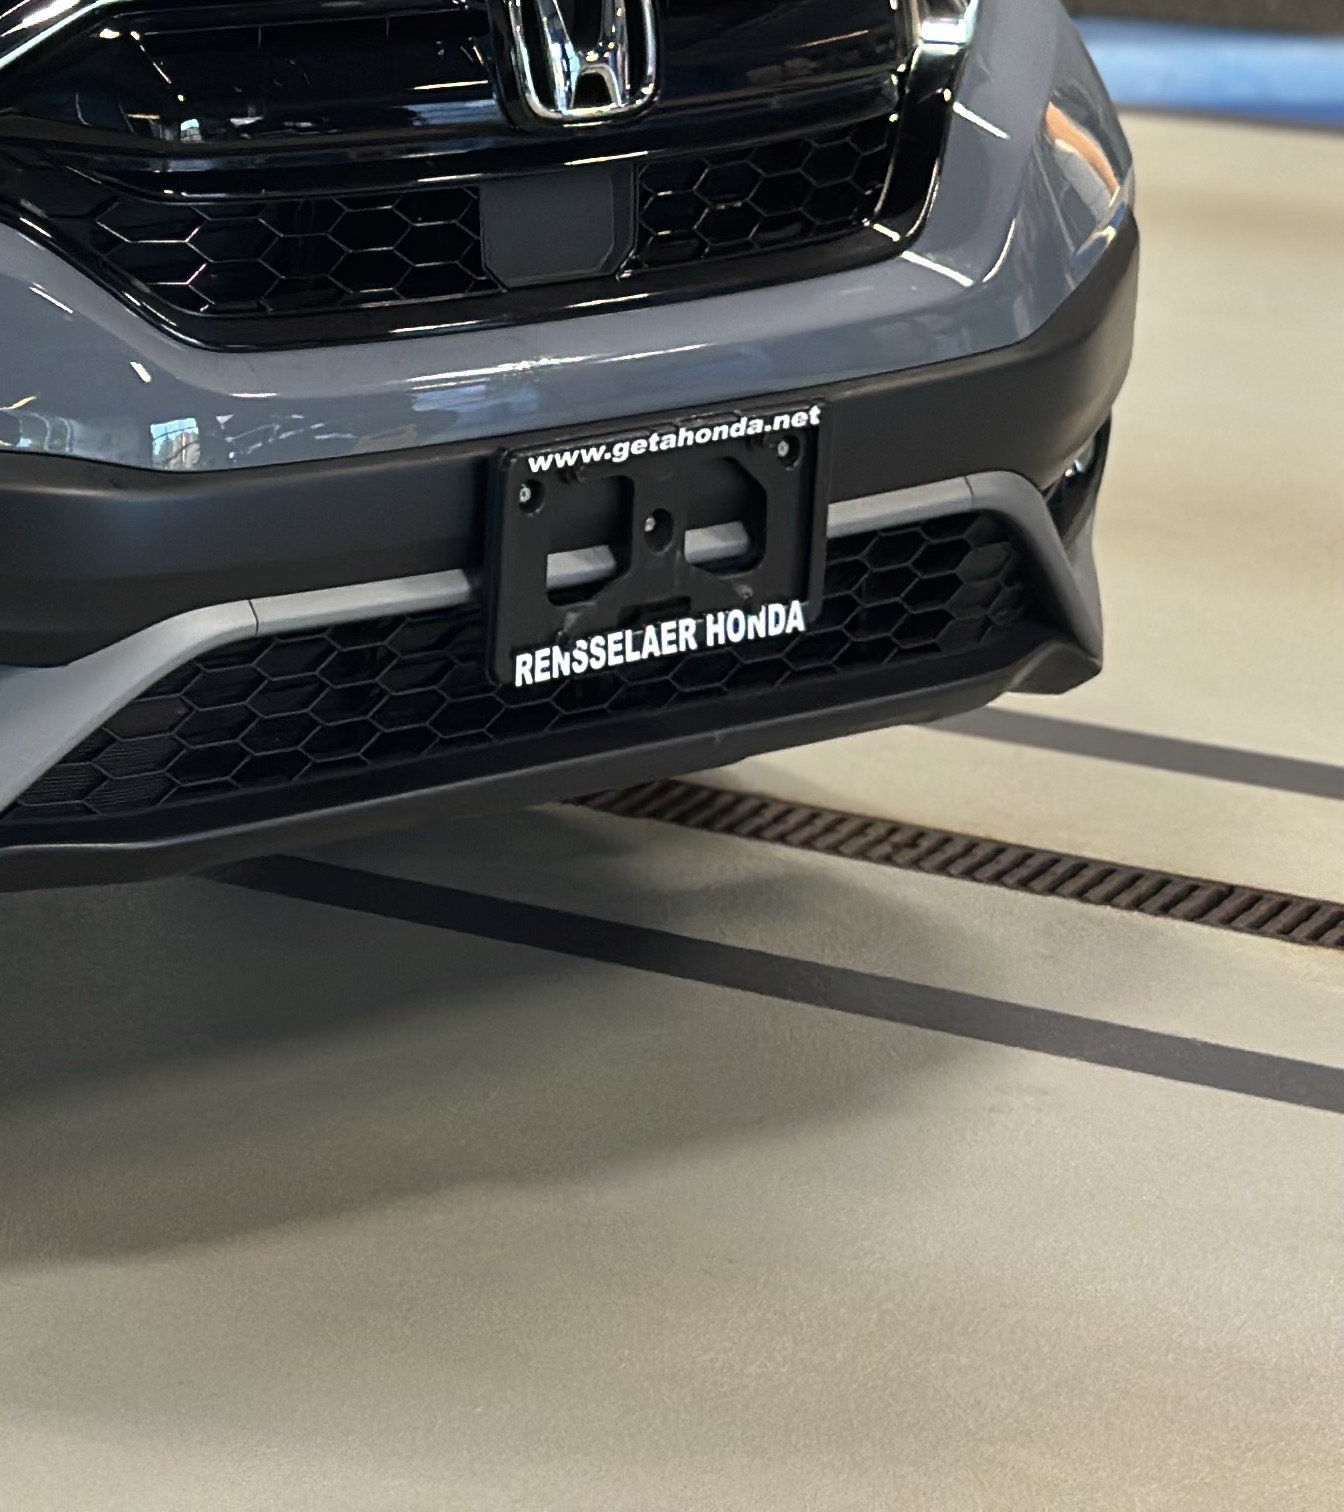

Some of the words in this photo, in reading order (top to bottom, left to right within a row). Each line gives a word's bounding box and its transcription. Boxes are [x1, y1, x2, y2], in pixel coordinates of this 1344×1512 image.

[527, 405, 821, 473] www.getahonda.net
[514, 617, 698, 687] RENSSELAER
[705, 599, 806, 647] HONDA
